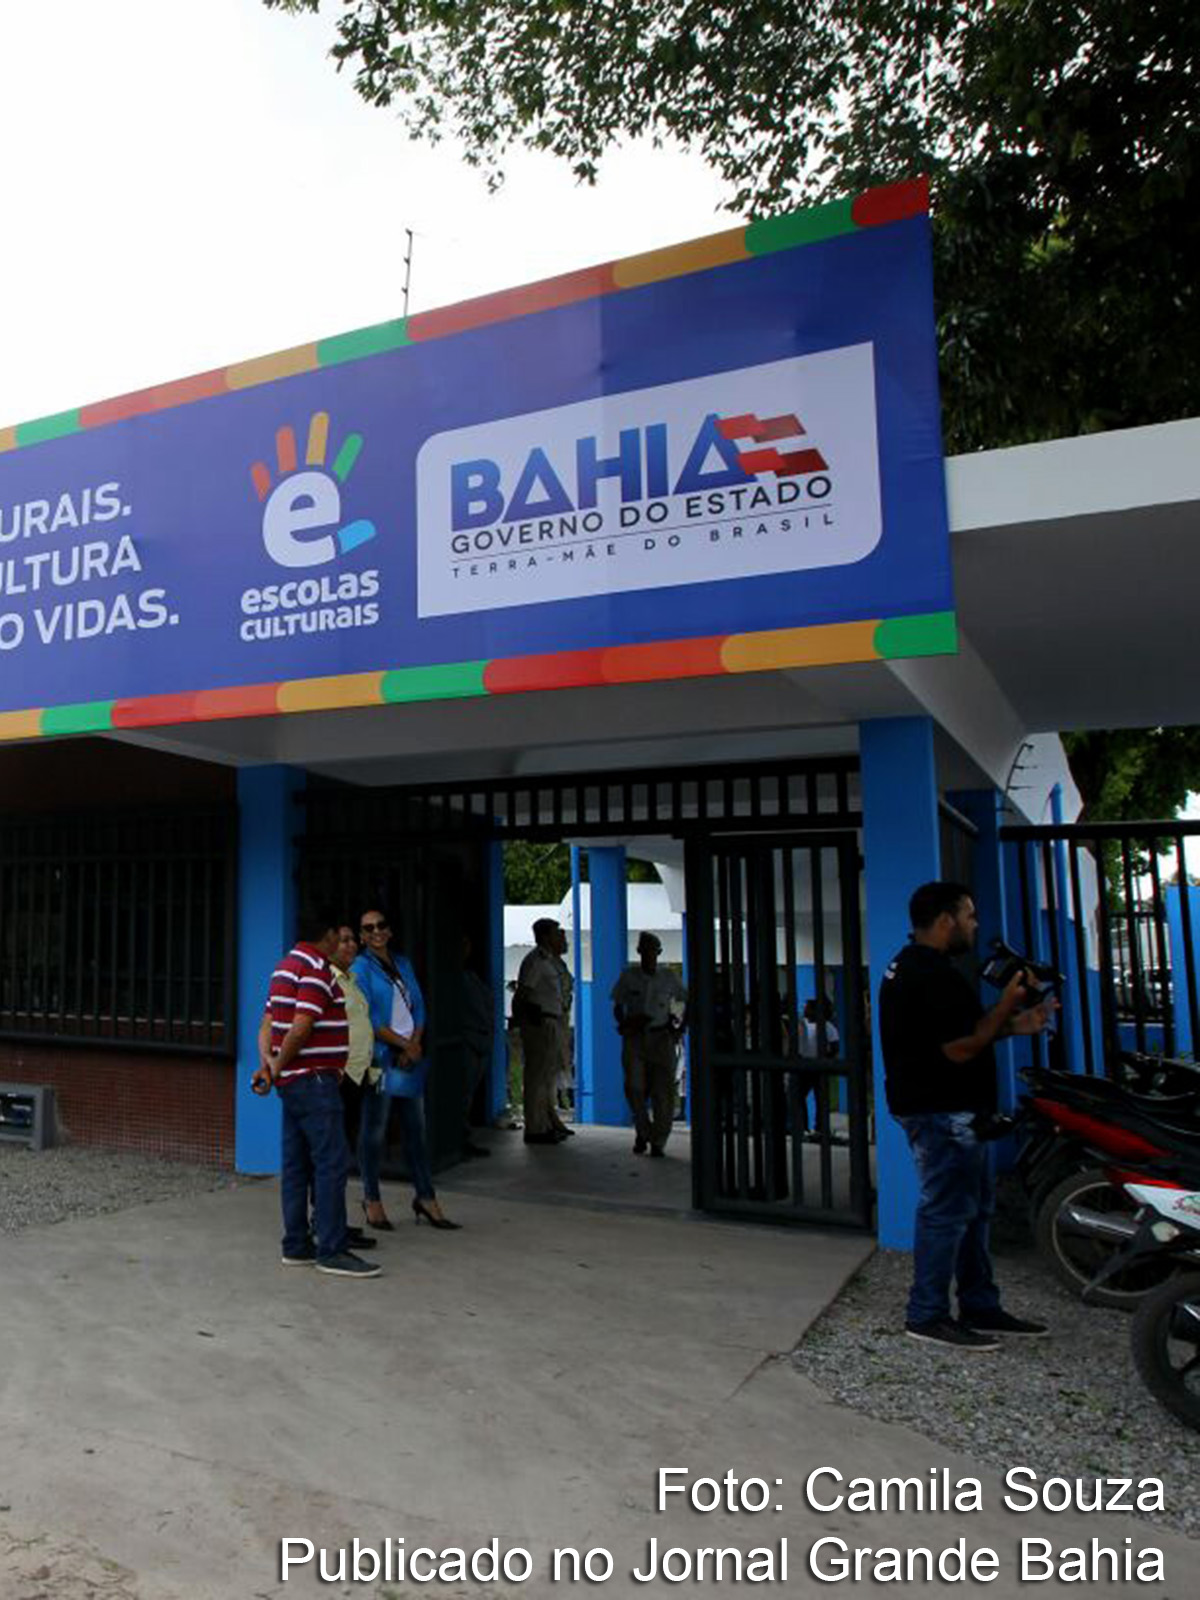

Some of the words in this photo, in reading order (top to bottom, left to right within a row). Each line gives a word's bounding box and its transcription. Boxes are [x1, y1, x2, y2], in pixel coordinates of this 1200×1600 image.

[450, 411, 761, 533] BAHIA
[450, 510, 604, 555] GOVERNO
[619, 500, 670, 528] DO
[685, 475, 832, 519] ESTADO
[451, 543, 618, 579] TERRA-MÃE
[643, 534, 681, 551] DO
[709, 512, 834, 543] BRASIL
[33, 589, 180, 645] VIDAS.
